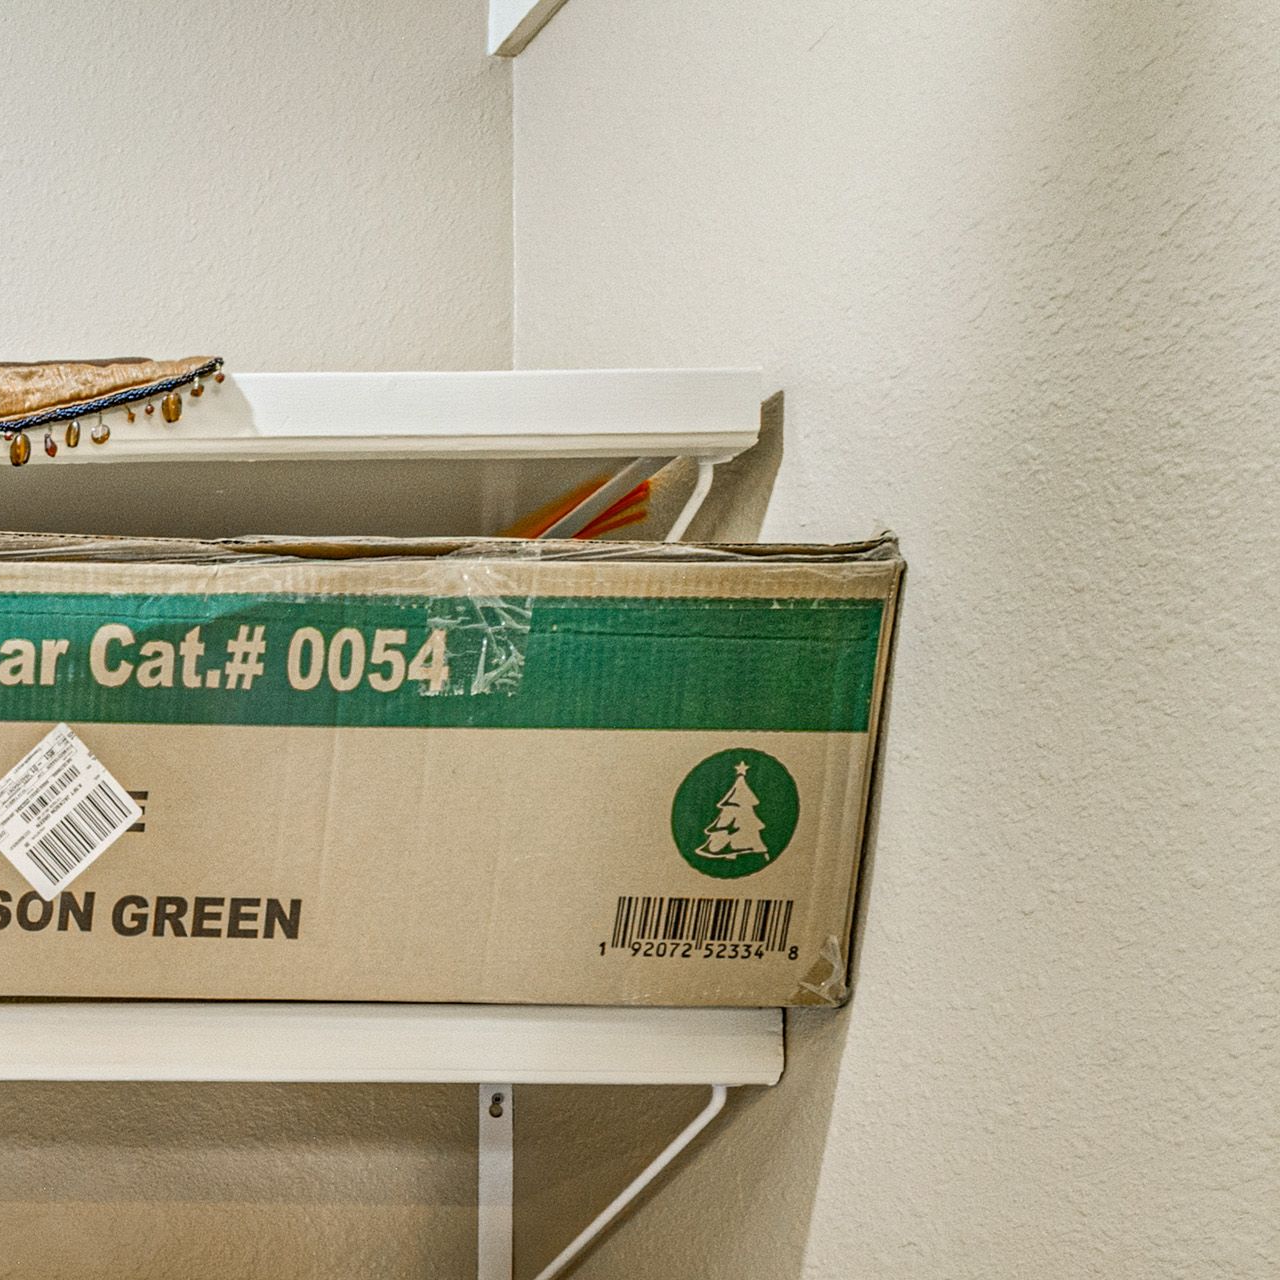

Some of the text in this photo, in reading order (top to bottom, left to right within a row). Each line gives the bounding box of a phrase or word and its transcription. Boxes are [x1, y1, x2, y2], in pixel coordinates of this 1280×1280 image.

[89, 623, 266, 690] Cat.#
[286, 626, 449, 692] 0054
[110, 895, 303, 940] GREEN
[599, 941, 799, 960] 1 92072 52334 8
